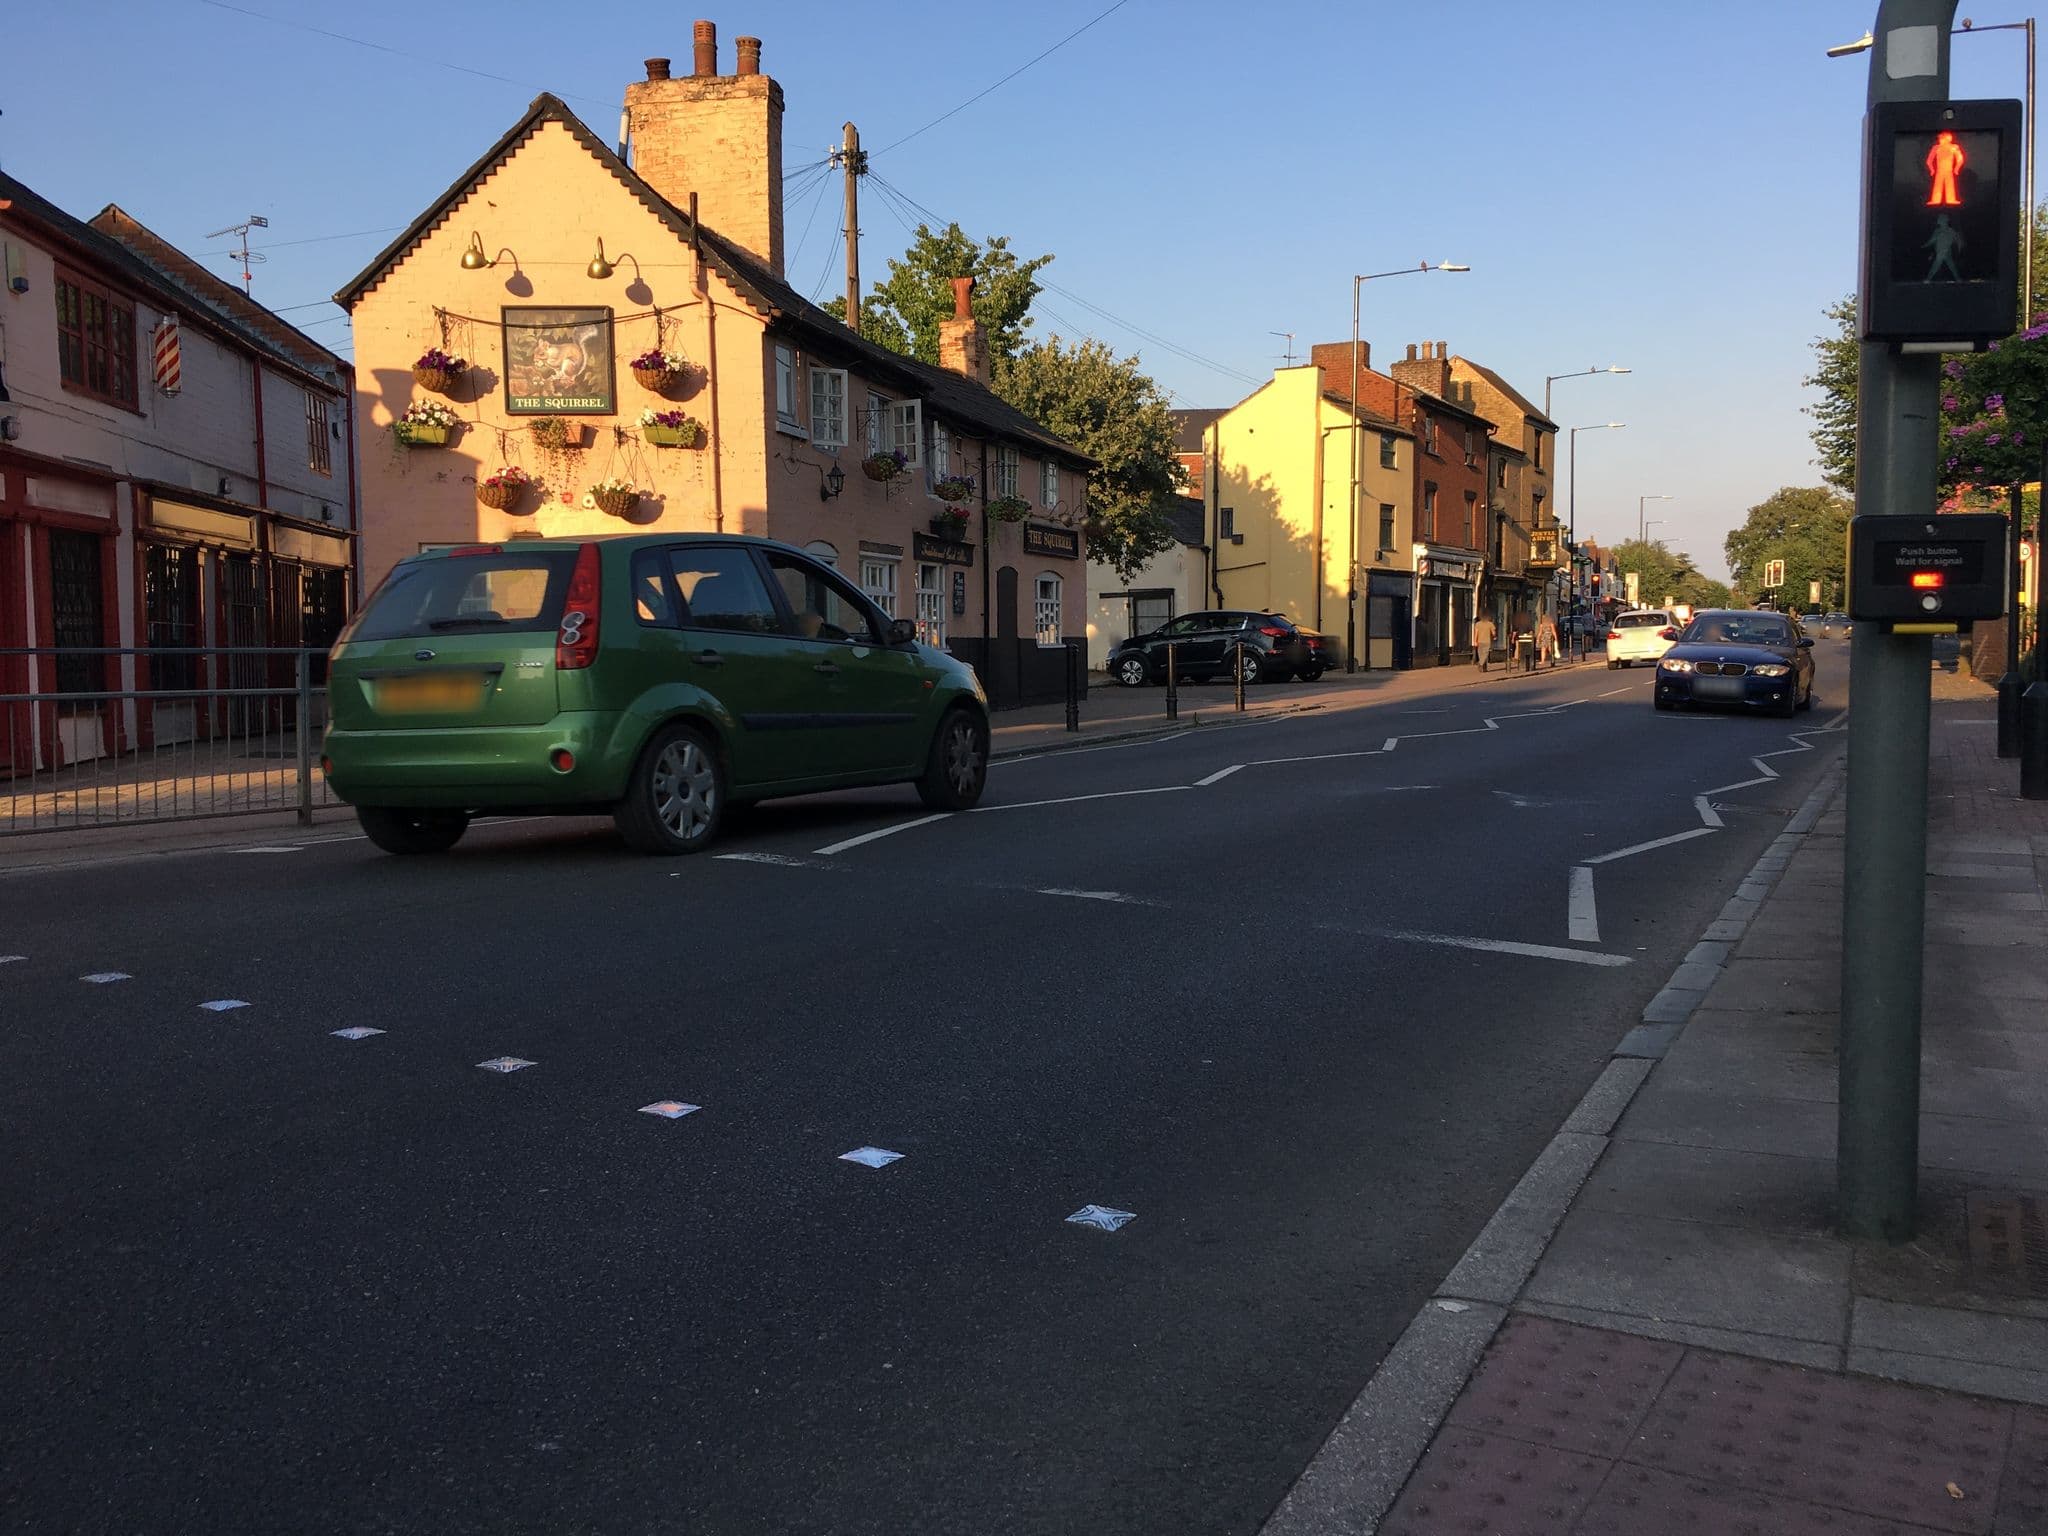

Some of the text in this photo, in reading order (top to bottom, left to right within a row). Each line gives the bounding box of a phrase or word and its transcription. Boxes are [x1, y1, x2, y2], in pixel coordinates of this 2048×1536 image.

[515, 398, 605, 409] THE SQUIRREL
[1027, 529, 1043, 545] THE
[1900, 547, 1958, 555] Push button
[1895, 557, 1963, 567] Wait for signal
